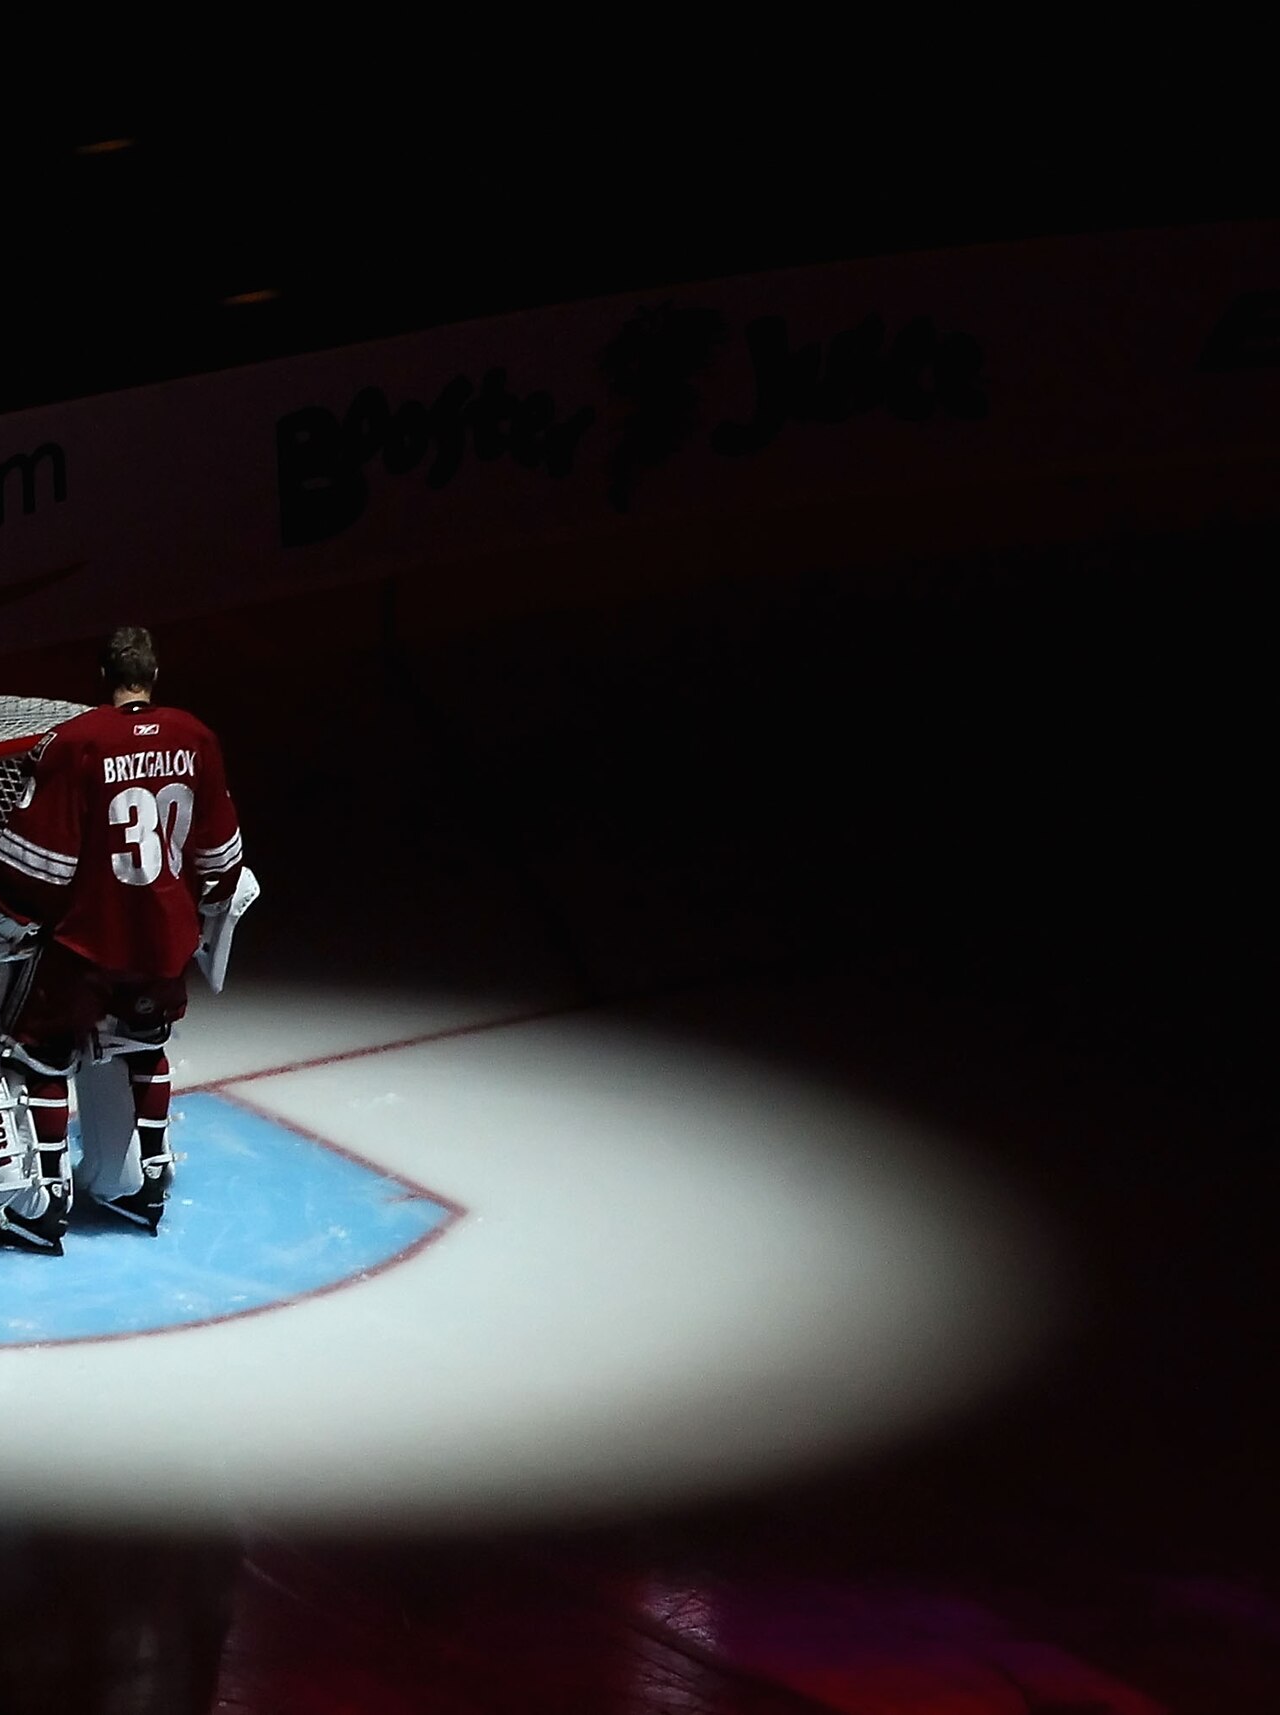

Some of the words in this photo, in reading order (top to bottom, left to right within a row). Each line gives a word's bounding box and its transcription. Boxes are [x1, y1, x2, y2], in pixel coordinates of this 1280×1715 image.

[276, 366, 596, 548] Booster
[103, 749, 197, 784] BRYZGALOV
[108, 782, 195, 886] 30
